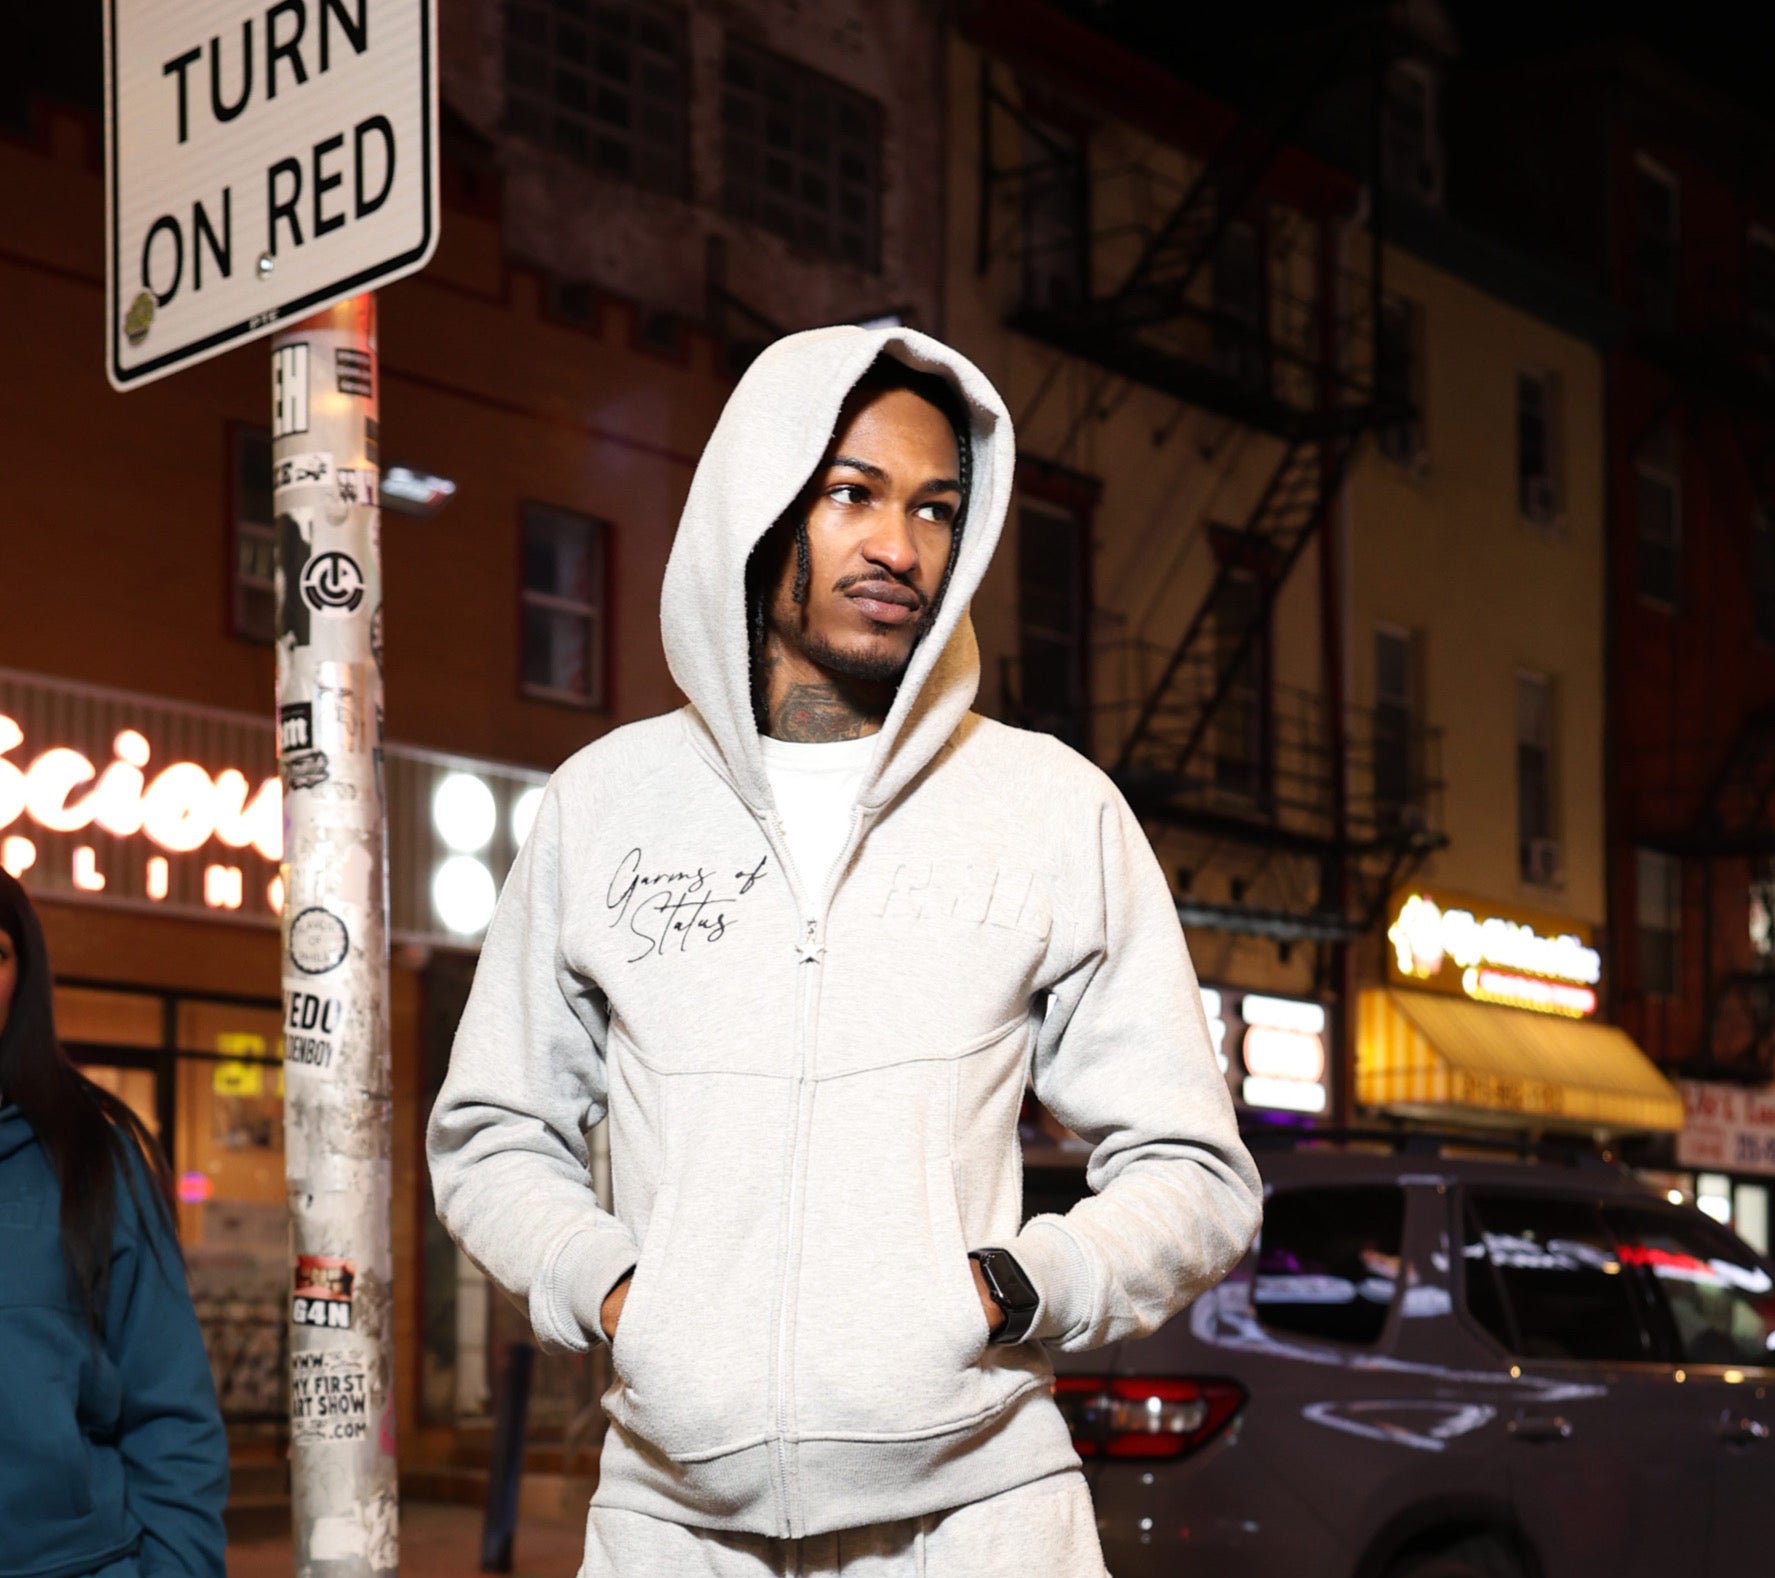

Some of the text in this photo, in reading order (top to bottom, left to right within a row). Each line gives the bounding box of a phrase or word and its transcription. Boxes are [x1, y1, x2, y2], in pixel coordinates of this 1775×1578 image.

[162, 0, 368, 144] TURN
[142, 114, 396, 308] ON RED
[607, 848, 768, 927] Garms of
[628, 890, 739, 963] Status
[315, 1373, 365, 1394] FIRST
[318, 1392, 366, 1417] SHOW
